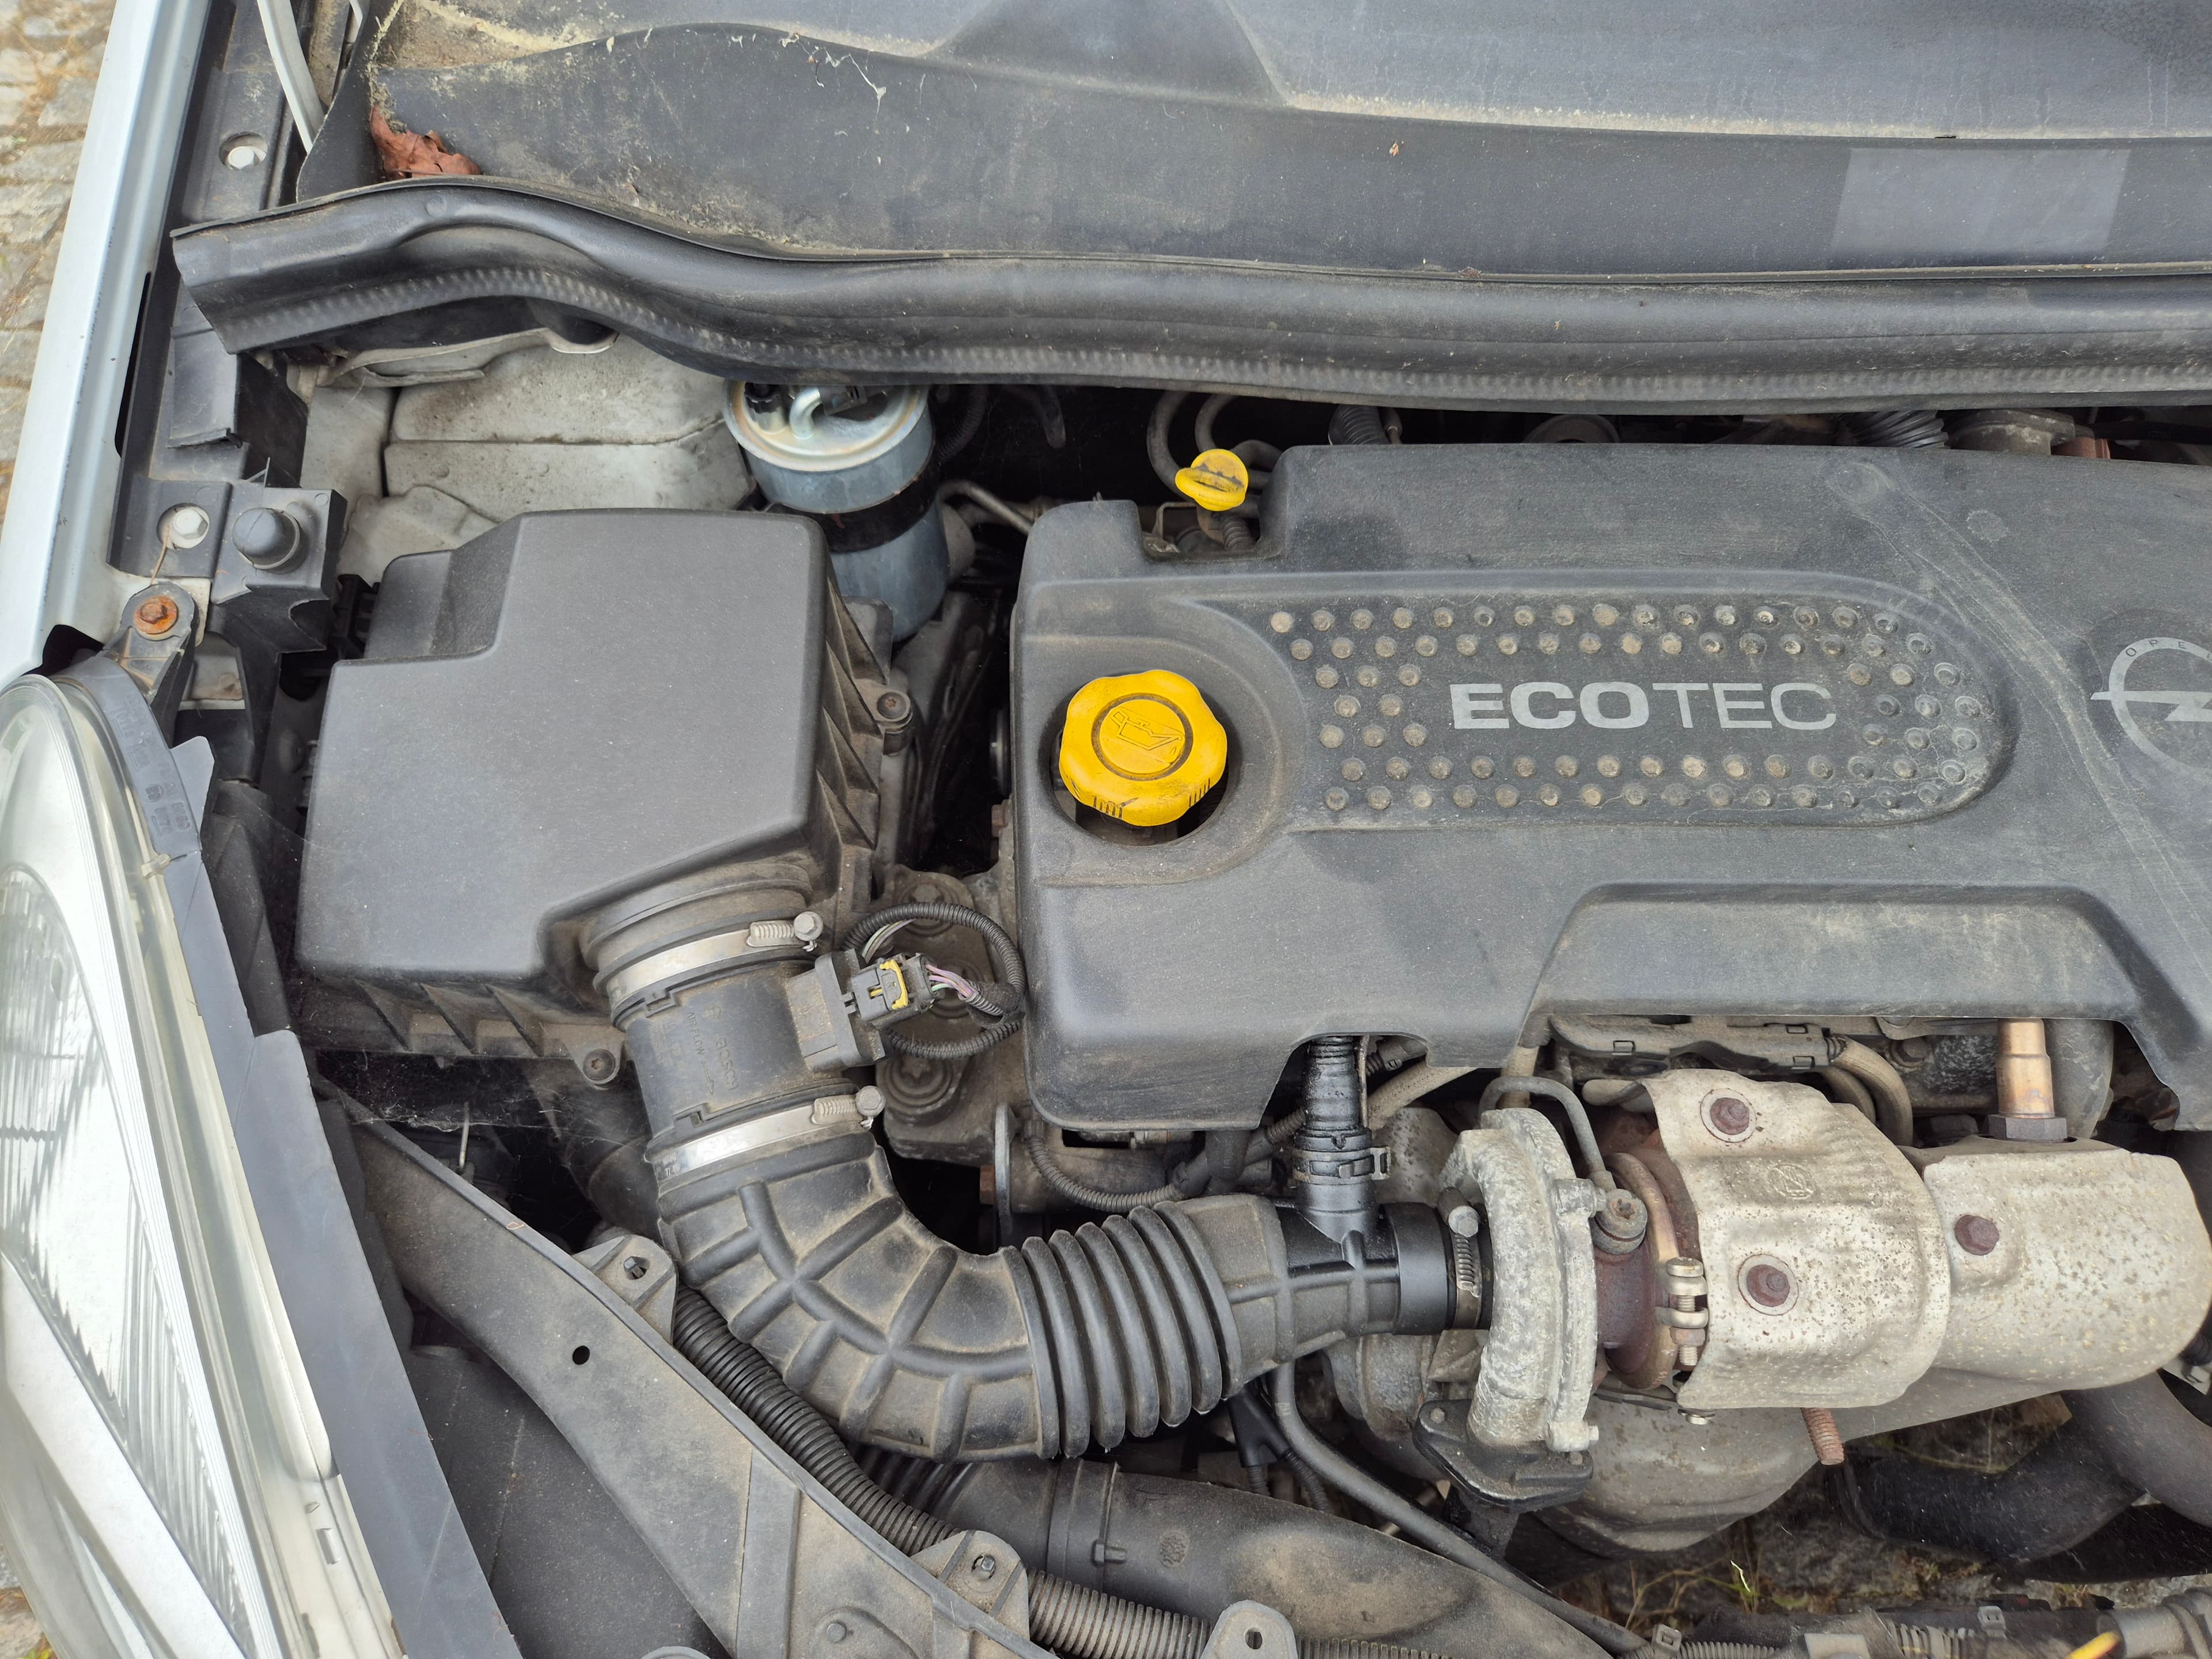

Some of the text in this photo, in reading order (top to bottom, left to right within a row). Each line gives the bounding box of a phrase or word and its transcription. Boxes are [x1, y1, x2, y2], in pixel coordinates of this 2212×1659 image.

[1449, 681, 1837, 730] ECOTEC
[687, 1012, 706, 1055] AIR FLOW
[715, 1037, 739, 1091] BOSCH
